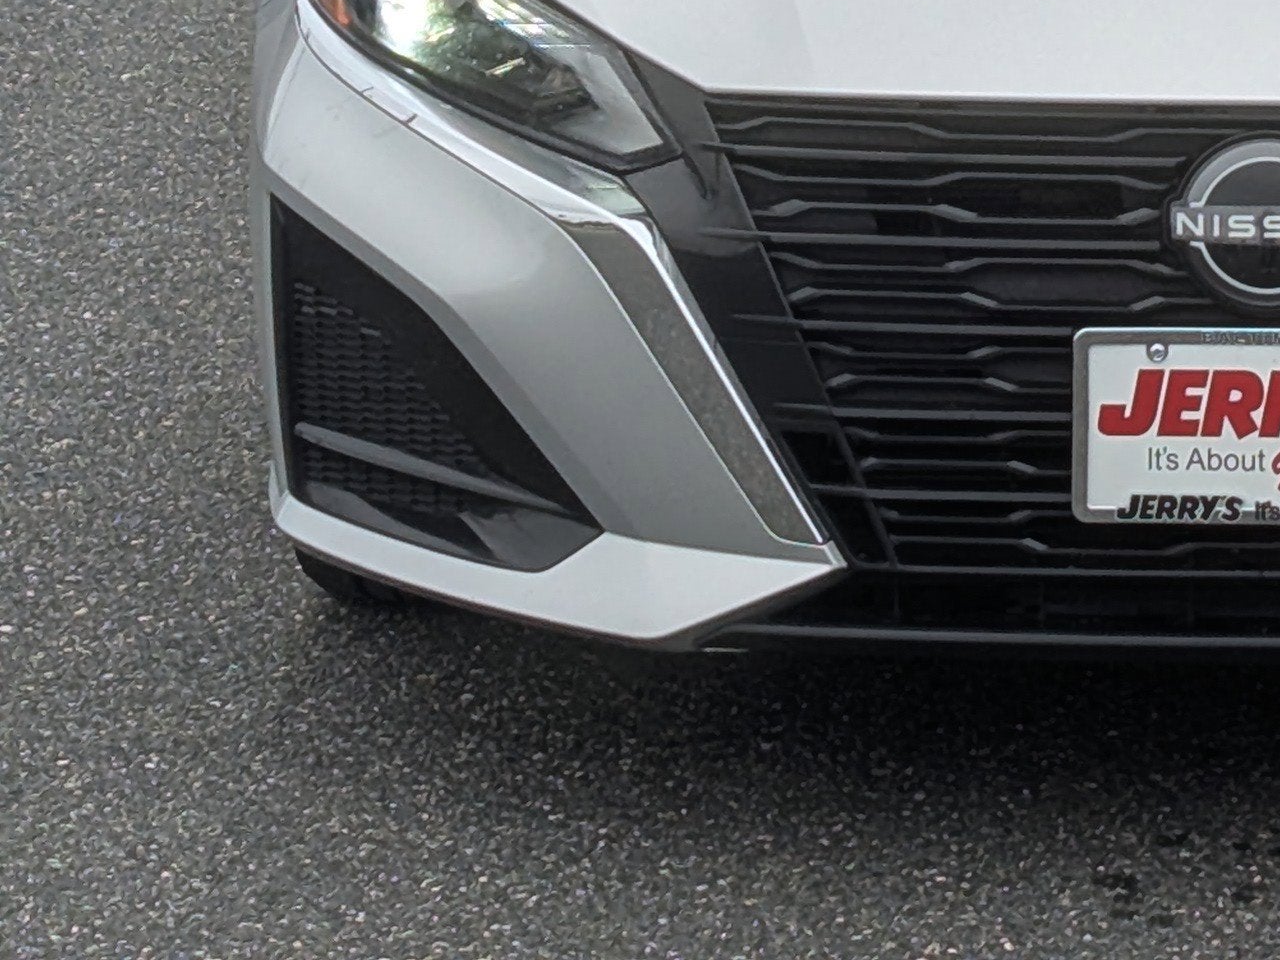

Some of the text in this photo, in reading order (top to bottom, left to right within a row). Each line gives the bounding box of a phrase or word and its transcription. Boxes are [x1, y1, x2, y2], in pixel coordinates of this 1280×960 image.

[1148, 446, 1179, 471] It's
[1186, 448, 1266, 471] About
[1117, 494, 1243, 521] JERRY'S
[1255, 502, 1280, 520] It's
